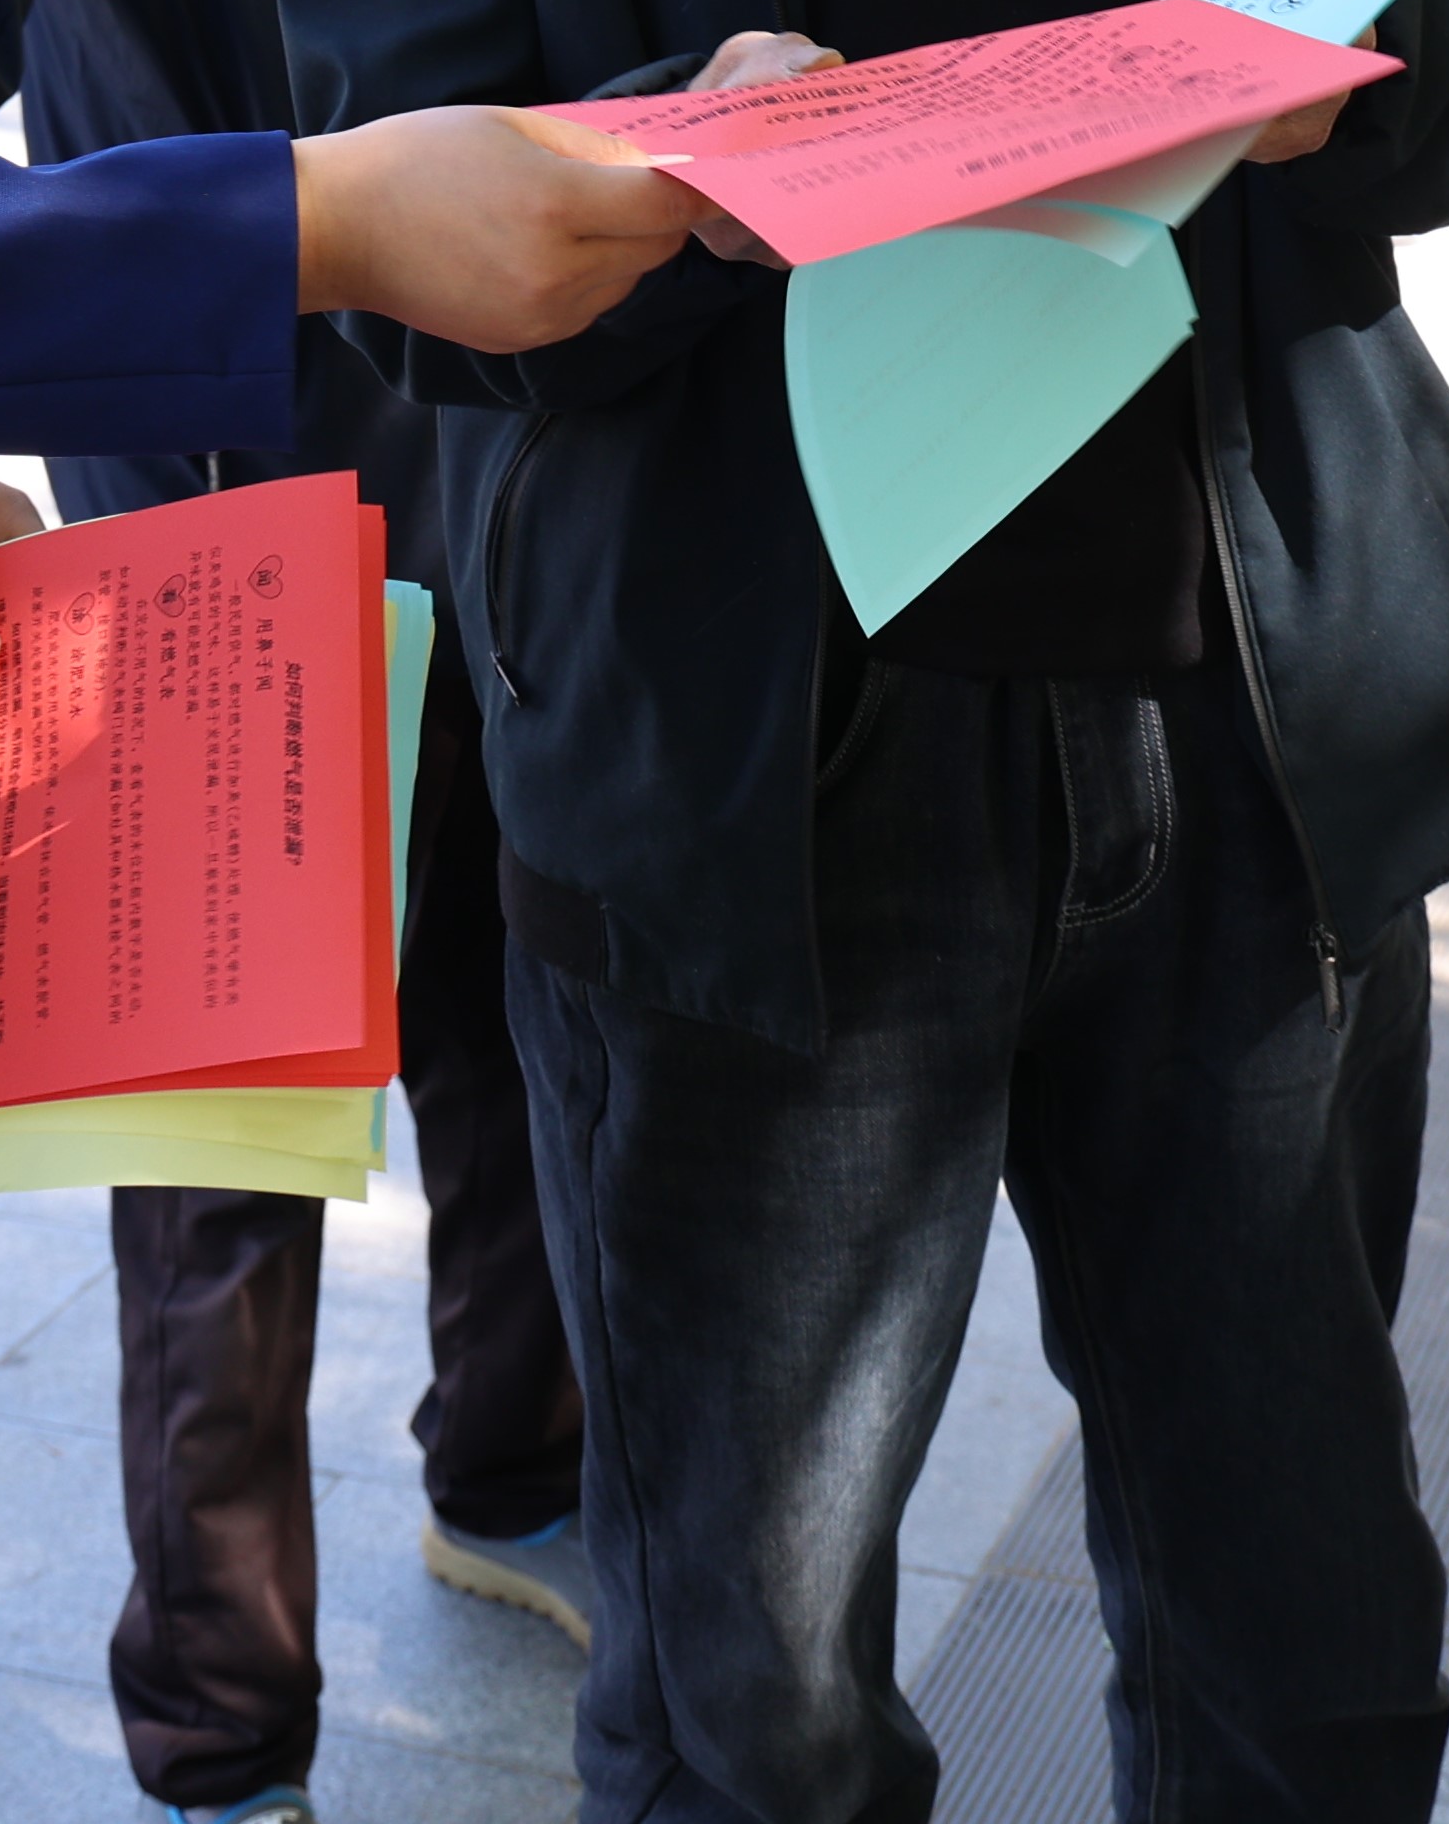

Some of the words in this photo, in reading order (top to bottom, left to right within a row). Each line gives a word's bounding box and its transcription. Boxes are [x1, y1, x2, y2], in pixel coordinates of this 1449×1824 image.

[68, 647, 85, 720] 涂肥皂水
[158, 628, 178, 701] 看燃气表
[255, 617, 273, 691] 用鼻子闻
